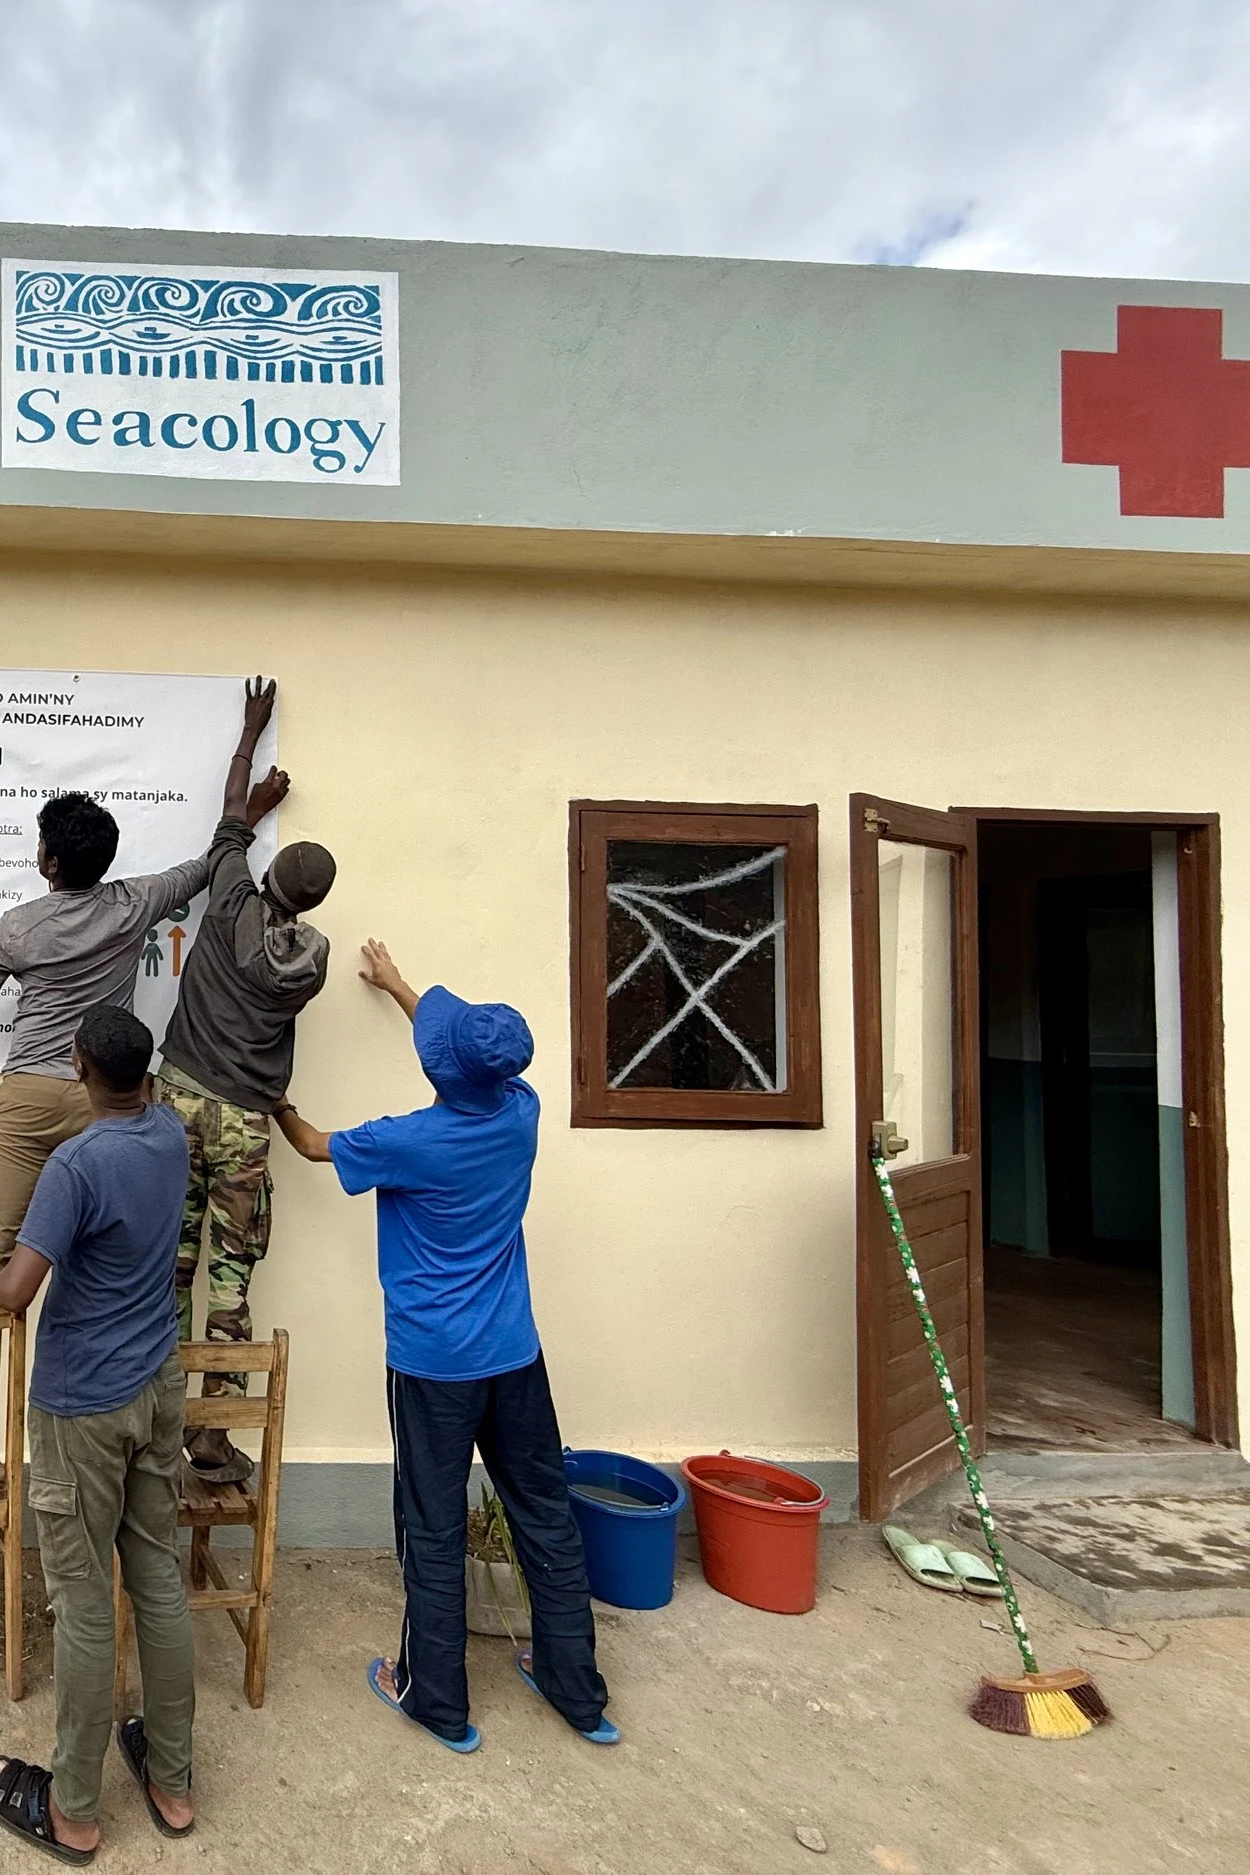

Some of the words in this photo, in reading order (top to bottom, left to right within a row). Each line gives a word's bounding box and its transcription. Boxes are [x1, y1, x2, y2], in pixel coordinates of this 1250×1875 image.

[16, 388, 385, 473] Seacology
[7, 693, 75, 706] AMIN'NY
[2, 712, 145, 728] ANDASIFAHADIMY
[20, 785, 38, 798] ho
[93, 790, 108, 803] sy
[111, 790, 188, 805] matanjaka.
